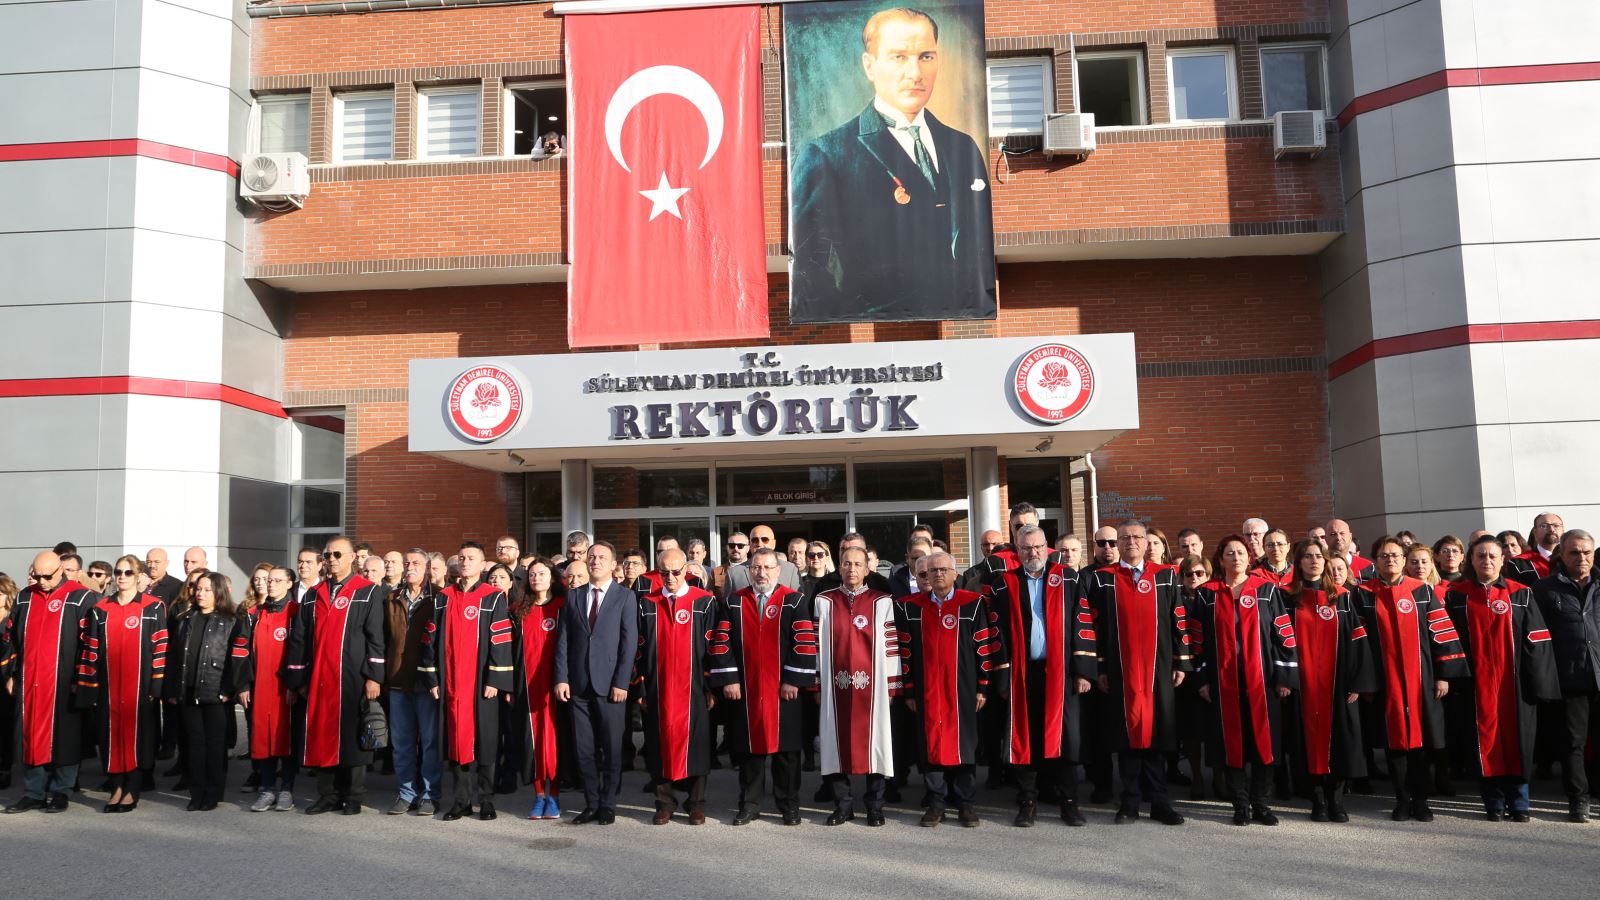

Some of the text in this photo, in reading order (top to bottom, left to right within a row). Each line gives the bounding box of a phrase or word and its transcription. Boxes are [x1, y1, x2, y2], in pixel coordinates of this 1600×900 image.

[1033, 347, 1062, 358] DEMİREL
[744, 352, 781, 368] T.C.
[588, 362, 944, 392] SÜLEYMAN DEMİREL ÜNİVERSİTESİ
[611, 388, 920, 440] REKTÖRLÜK
[1047, 410, 1063, 418] 1992
[477, 429, 493, 437] 1992
